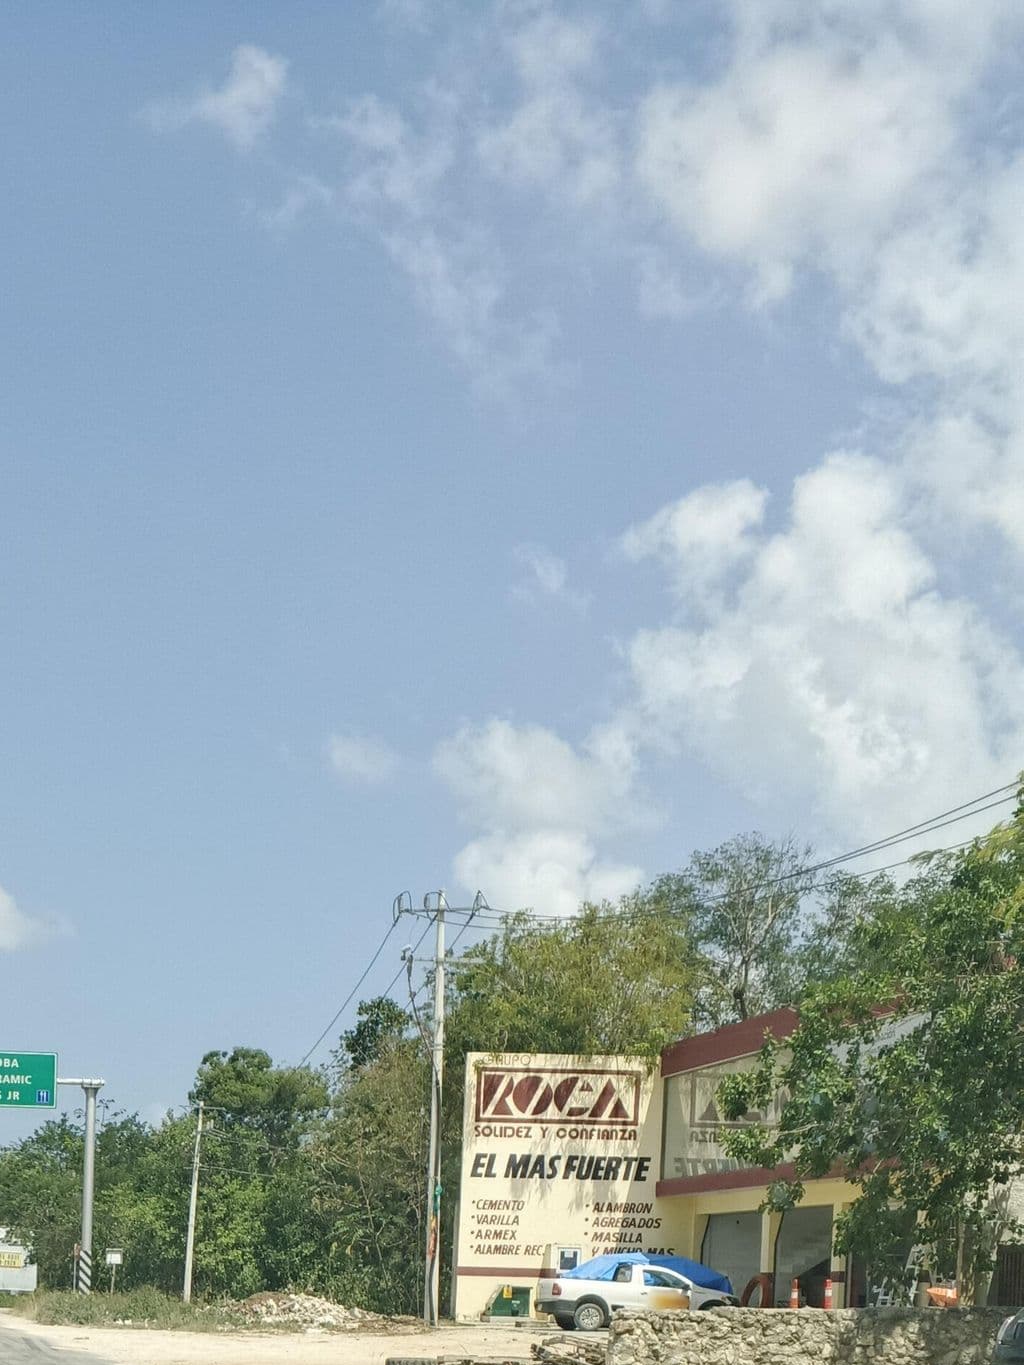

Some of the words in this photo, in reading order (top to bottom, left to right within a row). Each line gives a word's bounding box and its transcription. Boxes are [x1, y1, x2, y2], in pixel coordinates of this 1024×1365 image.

[7, 1091, 20, 1100] JR
[474, 1125, 533, 1139] SOLIDEZ
[539, 1127, 549, 1139] Y
[556, 1127, 638, 1141] CONFIANZA
[469, 1152, 497, 1178] EL
[503, 1153, 562, 1180] MAS
[562, 1154, 652, 1182] FUERTE
[476, 1199, 526, 1211] CEMENTO
[592, 1202, 654, 1214] ALAMBRON
[476, 1213, 520, 1226] VARILLA
[591, 1216, 663, 1229] AGREGADOS
[475, 1229, 518, 1241] ARMEX
[590, 1231, 643, 1243] MASILLA
[474, 1244, 522, 1256] ALAMBRE
[523, 1244, 546, 1256] REC.
[590, 1246, 600, 1257] Y
